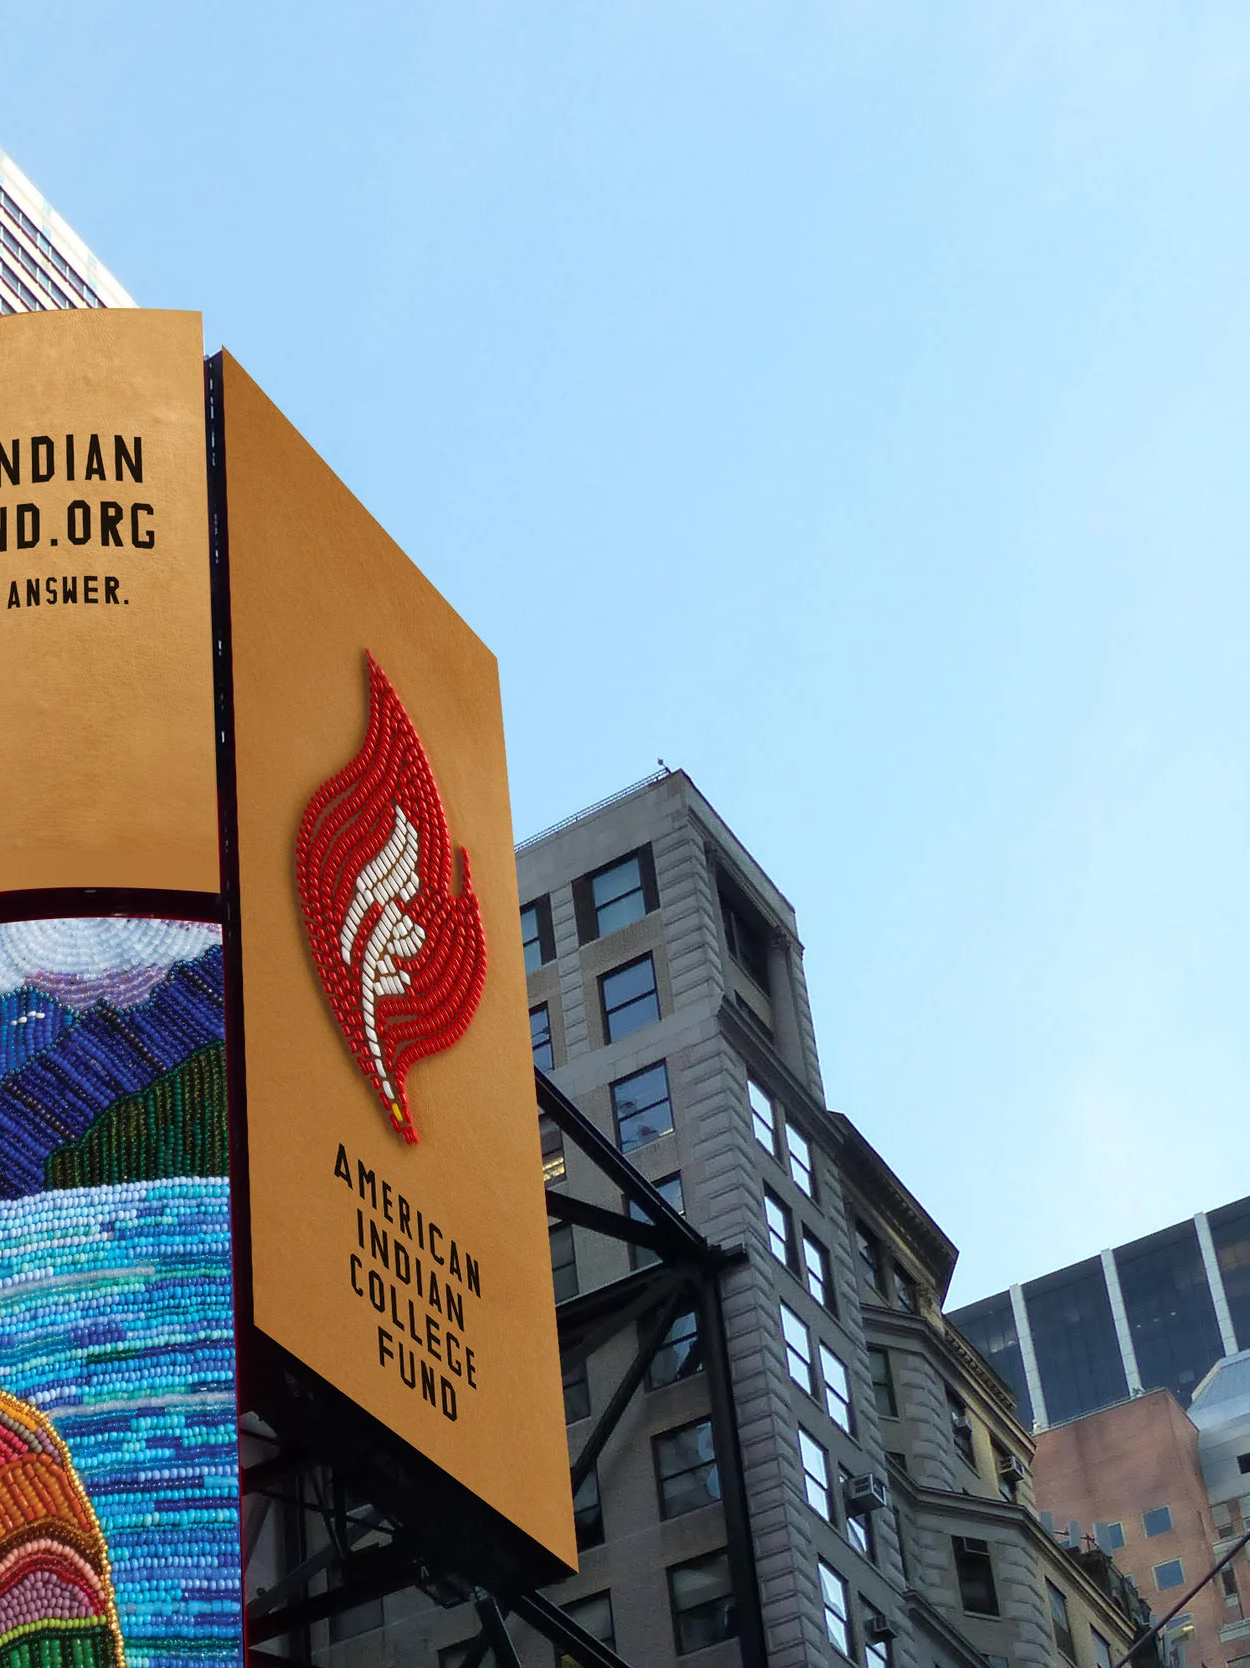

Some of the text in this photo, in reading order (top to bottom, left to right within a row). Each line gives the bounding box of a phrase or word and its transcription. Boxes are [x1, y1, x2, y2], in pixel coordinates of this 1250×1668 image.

[7, 575, 130, 610] ANSWER.
[334, 1143, 481, 1299] AMERICAN
[357, 1208, 464, 1332] INDIAN
[350, 1253, 477, 1390] COLLEGE
[378, 1325, 457, 1422] FUND
